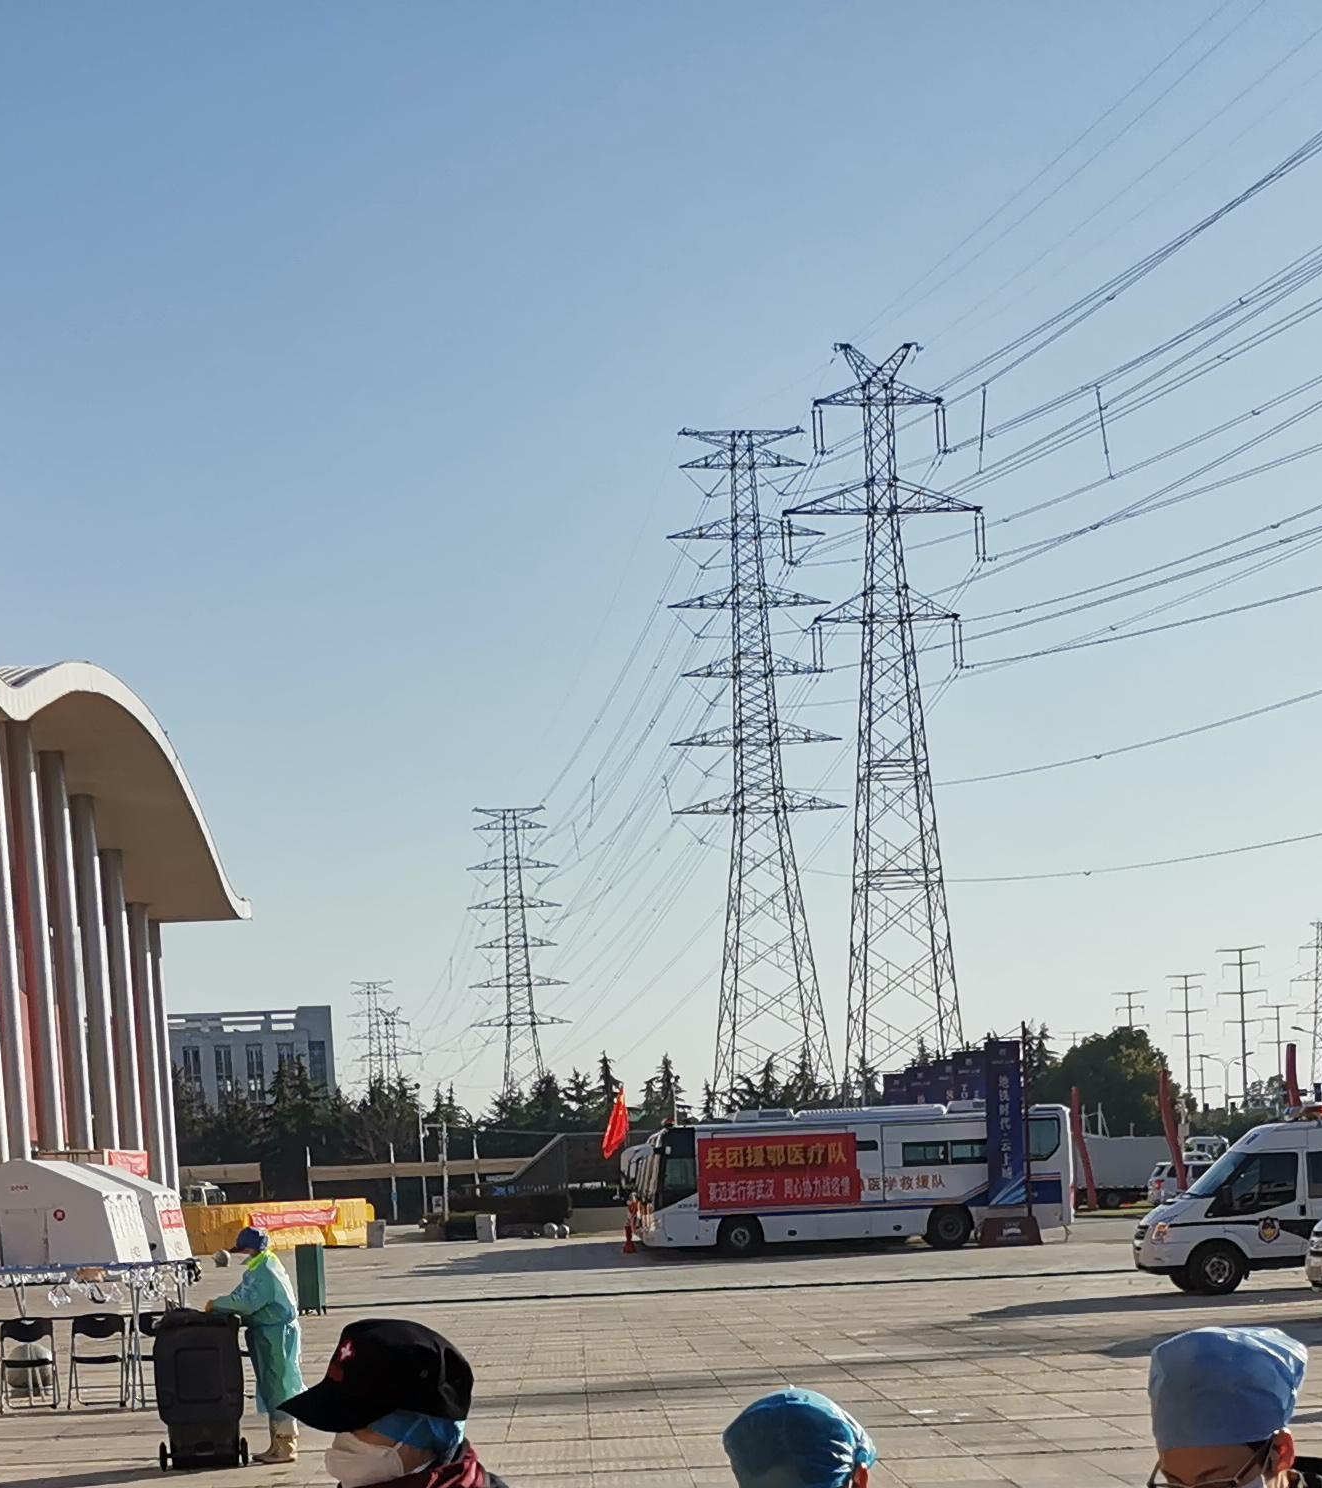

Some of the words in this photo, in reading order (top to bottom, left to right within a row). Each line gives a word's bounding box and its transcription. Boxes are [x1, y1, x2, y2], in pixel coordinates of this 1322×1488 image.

[706, 1141, 848, 1169] 兵团援鄂医疗队
